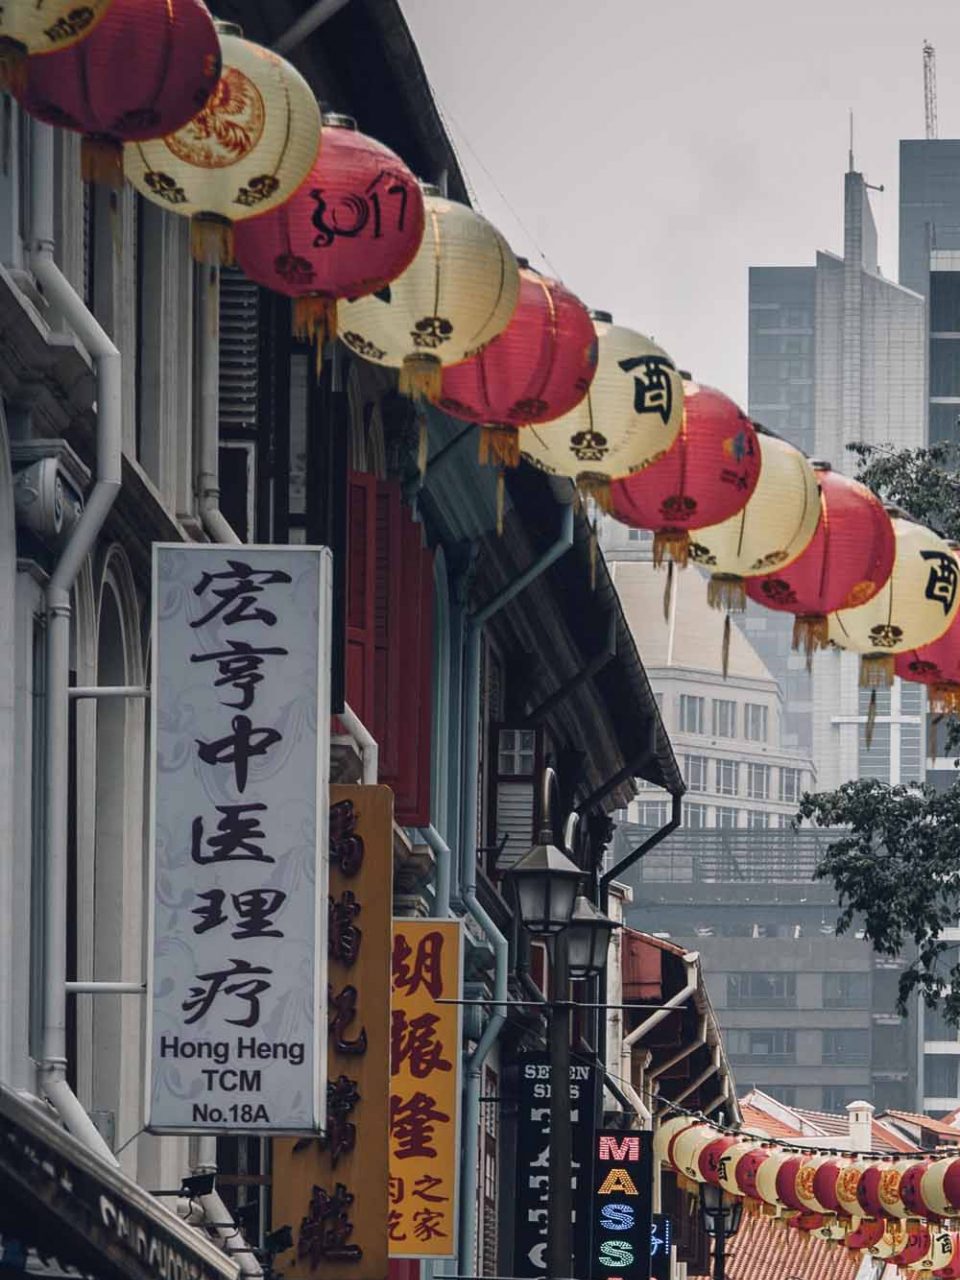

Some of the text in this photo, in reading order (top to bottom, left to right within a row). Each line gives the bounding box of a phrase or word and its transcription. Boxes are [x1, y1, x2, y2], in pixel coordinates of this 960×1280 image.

[181, 560, 292, 1028] 宏亨中医理疗
[159, 1036, 305, 1065] Hong Heng
[201, 1068, 262, 1092] TCM
[524, 1065, 590, 1080] SEEN
[533, 1084, 580, 1099] SIS
[192, 1103, 270, 1124] No.18A
